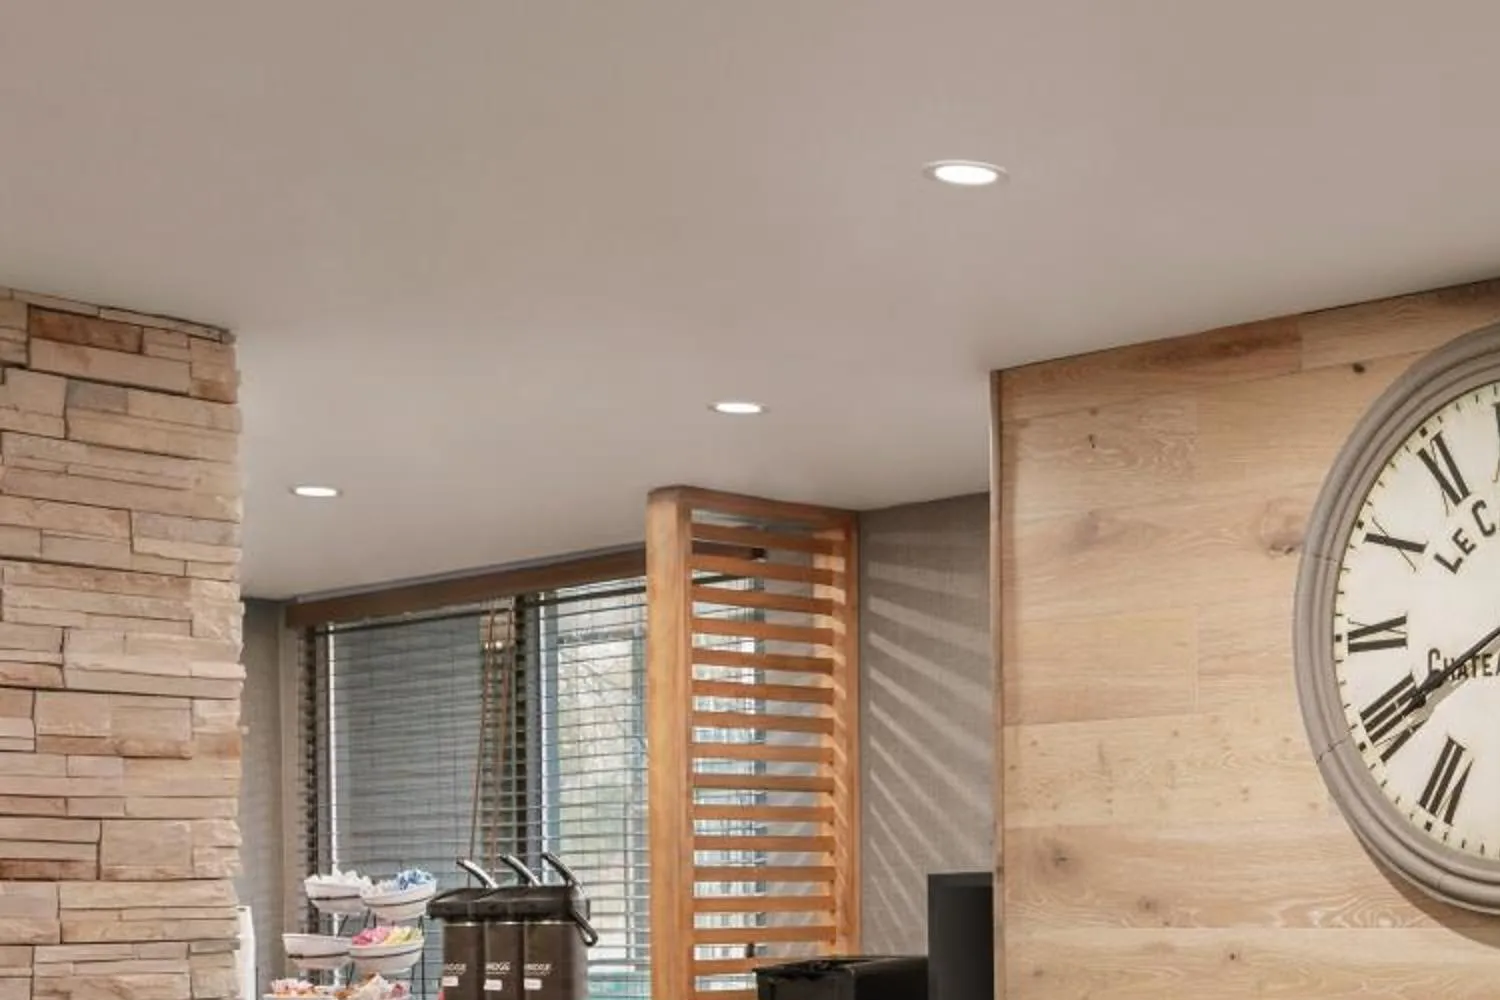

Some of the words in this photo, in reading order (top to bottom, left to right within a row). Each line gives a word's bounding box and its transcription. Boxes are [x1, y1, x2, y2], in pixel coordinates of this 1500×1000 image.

[1416, 429, 1471, 516] XI
[1364, 517, 1427, 572] X
[1433, 530, 1479, 576] LE
[1345, 612, 1410, 654] IX
